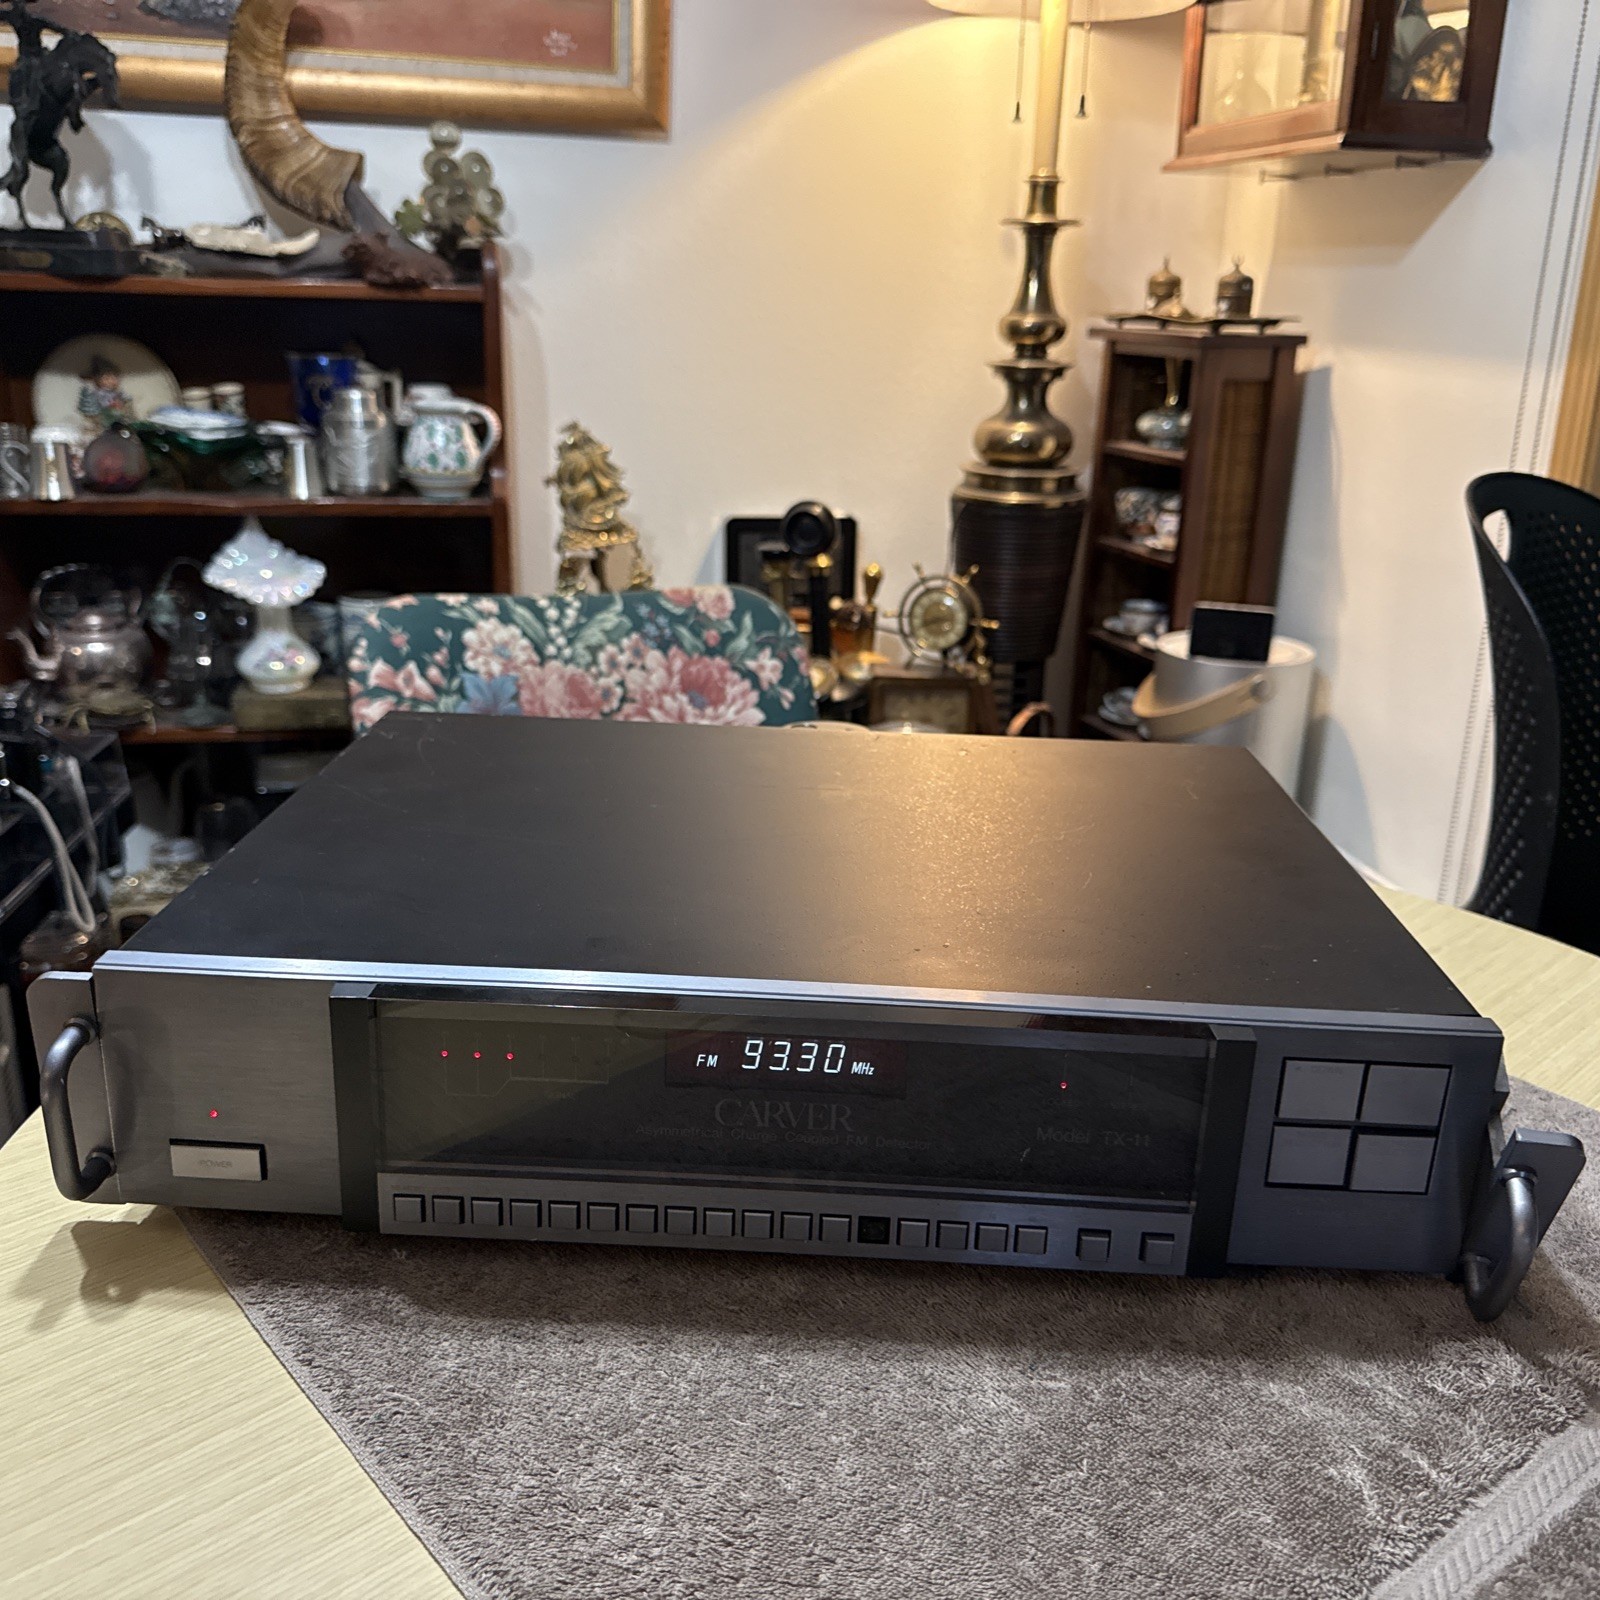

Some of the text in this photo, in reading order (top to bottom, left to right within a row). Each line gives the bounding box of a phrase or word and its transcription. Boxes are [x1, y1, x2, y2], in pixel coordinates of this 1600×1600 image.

[696, 1038, 876, 1077] FM 93.30 MHz
[713, 1098, 856, 1133] CARVER
[1036, 1126, 1152, 1147] Model TX-11
[198, 1158, 233, 1169] POWER
